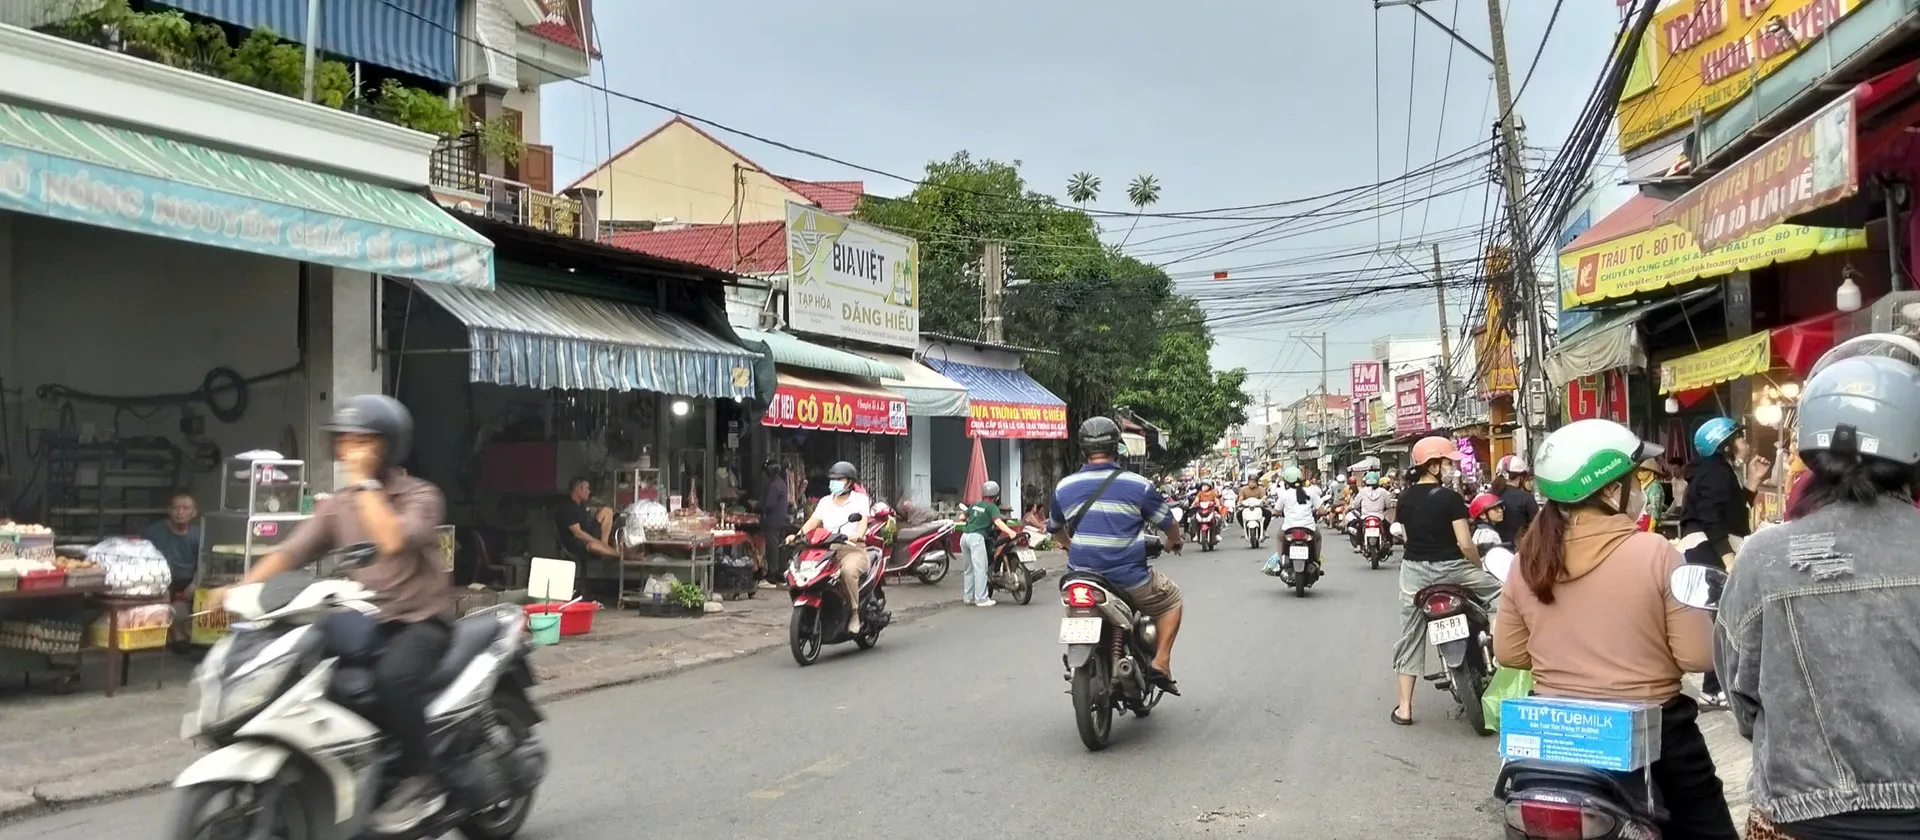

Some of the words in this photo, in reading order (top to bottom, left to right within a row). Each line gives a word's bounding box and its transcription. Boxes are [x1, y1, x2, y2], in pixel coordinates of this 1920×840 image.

[798, 292, 812, 310] TẠP
[842, 300, 881, 326] ĐĂNG
[885, 310, 914, 332] HIẾU
[797, 393, 819, 423] CÔ
[822, 394, 853, 426] HẢO
[970, 405, 989, 421] VỰA
[1594, 458, 1622, 478] Manulife
[1434, 617, 1461, 631] 36-B3
[1518, 707, 1540, 720] TH
[1534, 794, 1568, 803] HONDA
